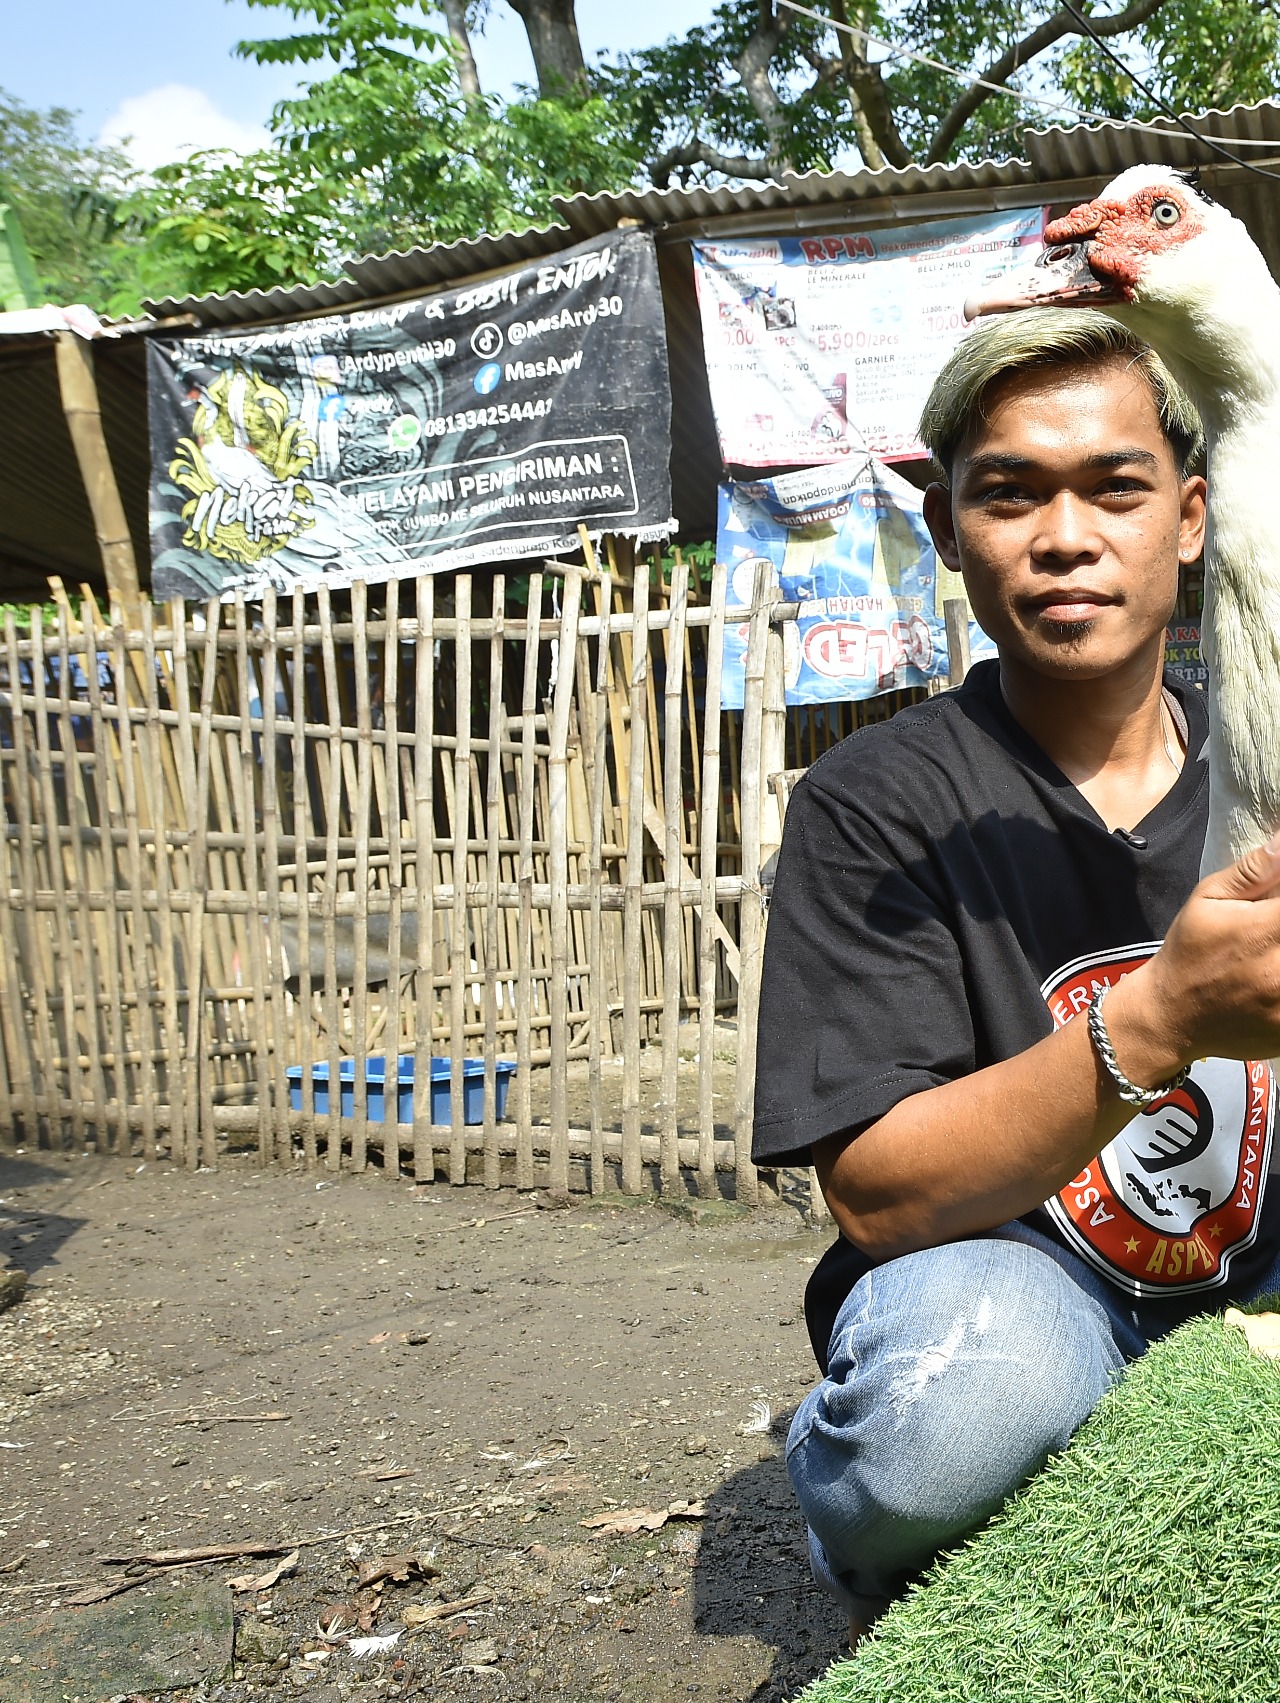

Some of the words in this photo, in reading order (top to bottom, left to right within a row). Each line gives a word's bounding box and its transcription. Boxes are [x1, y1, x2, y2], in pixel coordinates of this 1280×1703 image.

[801, 237, 876, 263] RPM
[880, 237, 948, 252] Rekomendasi
[981, 240, 999, 252] Juli
[917, 264, 937, 273] BELI
[947, 259, 972, 269] MILO
[807, 276, 817, 284] LE
[820, 272, 867, 282] MINERALE
[344, 337, 457, 373] Ardypentil30
[854, 354, 896, 366] GARNIER
[424, 397, 554, 438] 081334254441
[348, 479, 456, 512] MELAYANI
[458, 451, 604, 499] PENGIRIMAN
[782, 479, 857, 505] mendapatkan
[402, 511, 450, 532] JUMBO
[450, 508, 468, 523] KE
[469, 491, 526, 518] SELURUH
[528, 482, 626, 506] NUSANTARA
[811, 502, 851, 520] LOGAM
[828, 599, 884, 613] HADIAH
[1234, 1058, 1266, 1210] SANTARA
